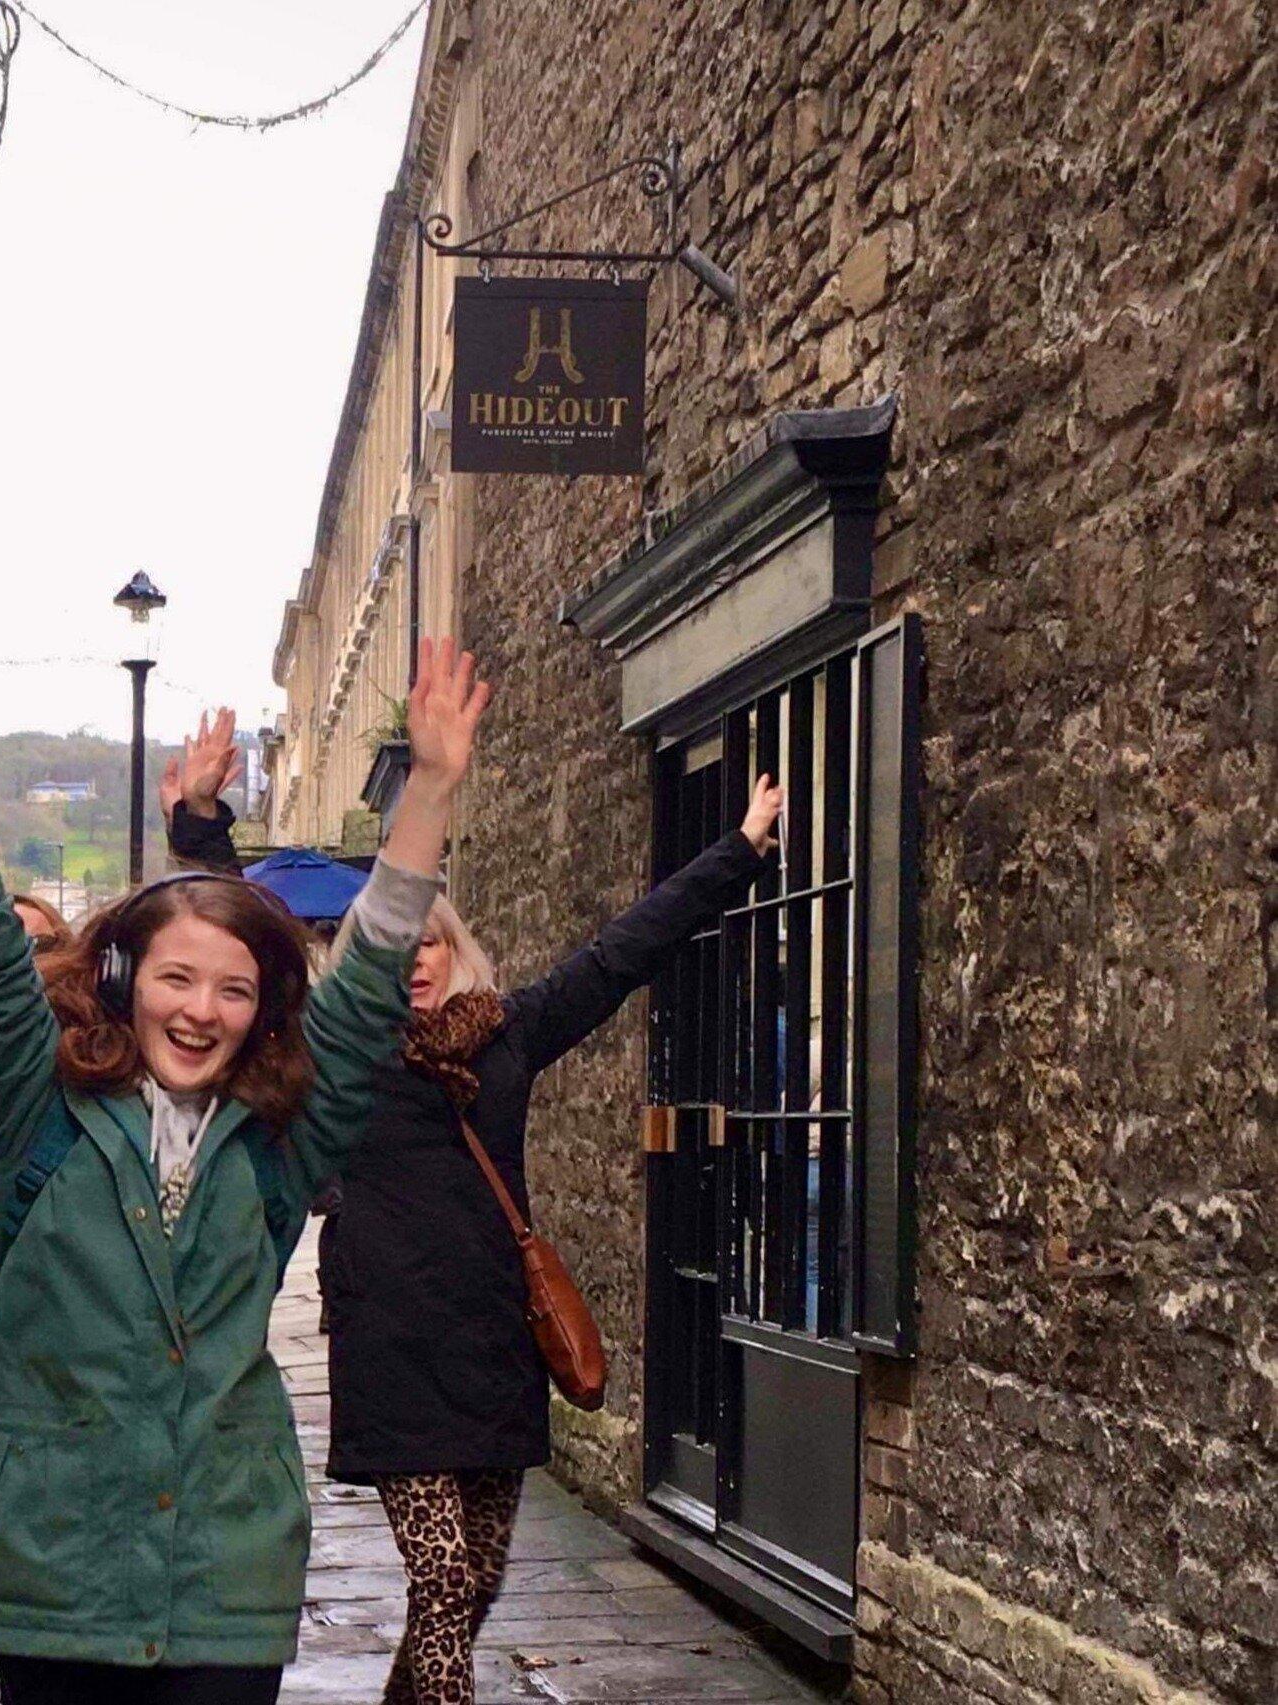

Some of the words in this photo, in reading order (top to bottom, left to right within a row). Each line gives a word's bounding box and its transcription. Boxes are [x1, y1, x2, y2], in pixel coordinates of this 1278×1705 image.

[538, 385, 561, 395] THE
[469, 393, 629, 427] HIDEOUT
[538, 429, 550, 437] OF
